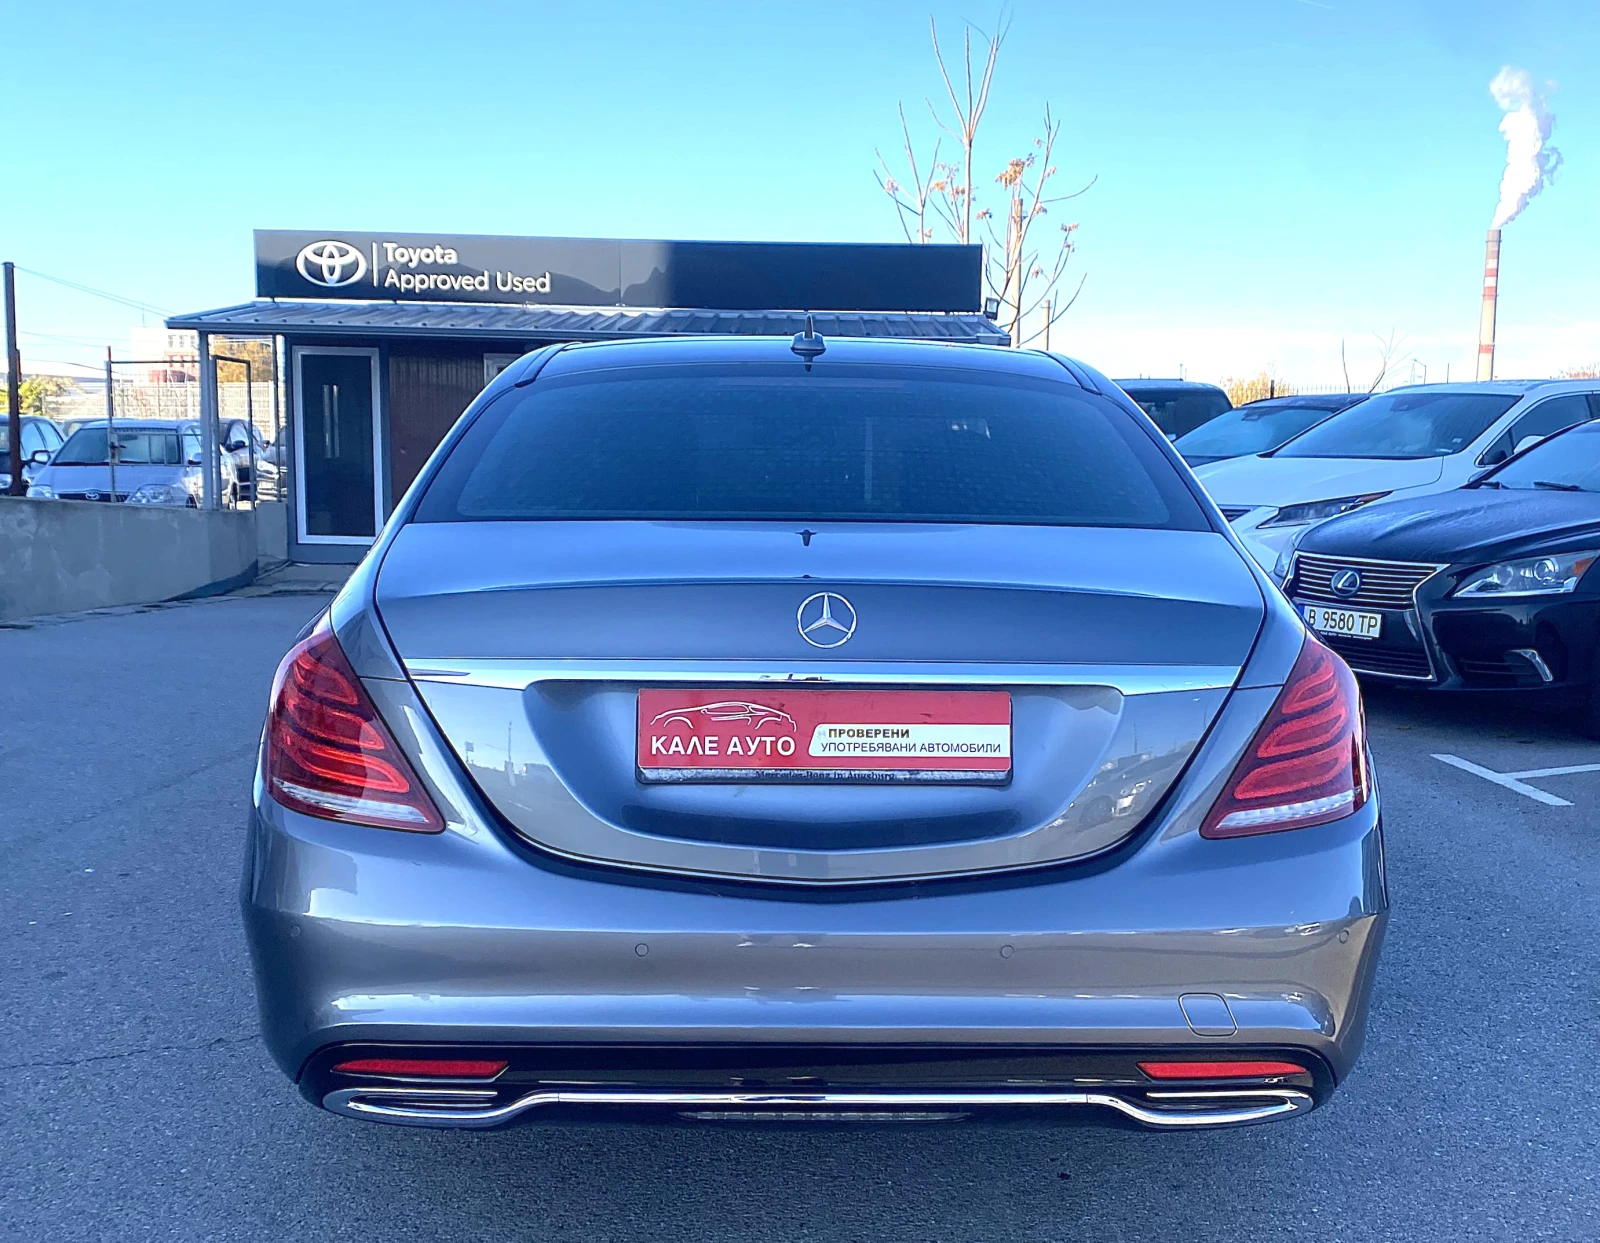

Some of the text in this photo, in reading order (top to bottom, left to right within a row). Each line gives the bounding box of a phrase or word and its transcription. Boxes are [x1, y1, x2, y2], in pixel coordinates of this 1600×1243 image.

[382, 242, 458, 268] Toyota
[384, 269, 551, 293] Approved Used
[1322, 611, 1355, 631] 9580
[1358, 615, 1378, 634] TP
[828, 728, 910, 739] ПРОВЕРЕНИ
[651, 736, 796, 756] КАЛЕ АУТО
[821, 742, 1001, 754] УПОТРЕБЯВАНИ АВТОМОБИЛИ
